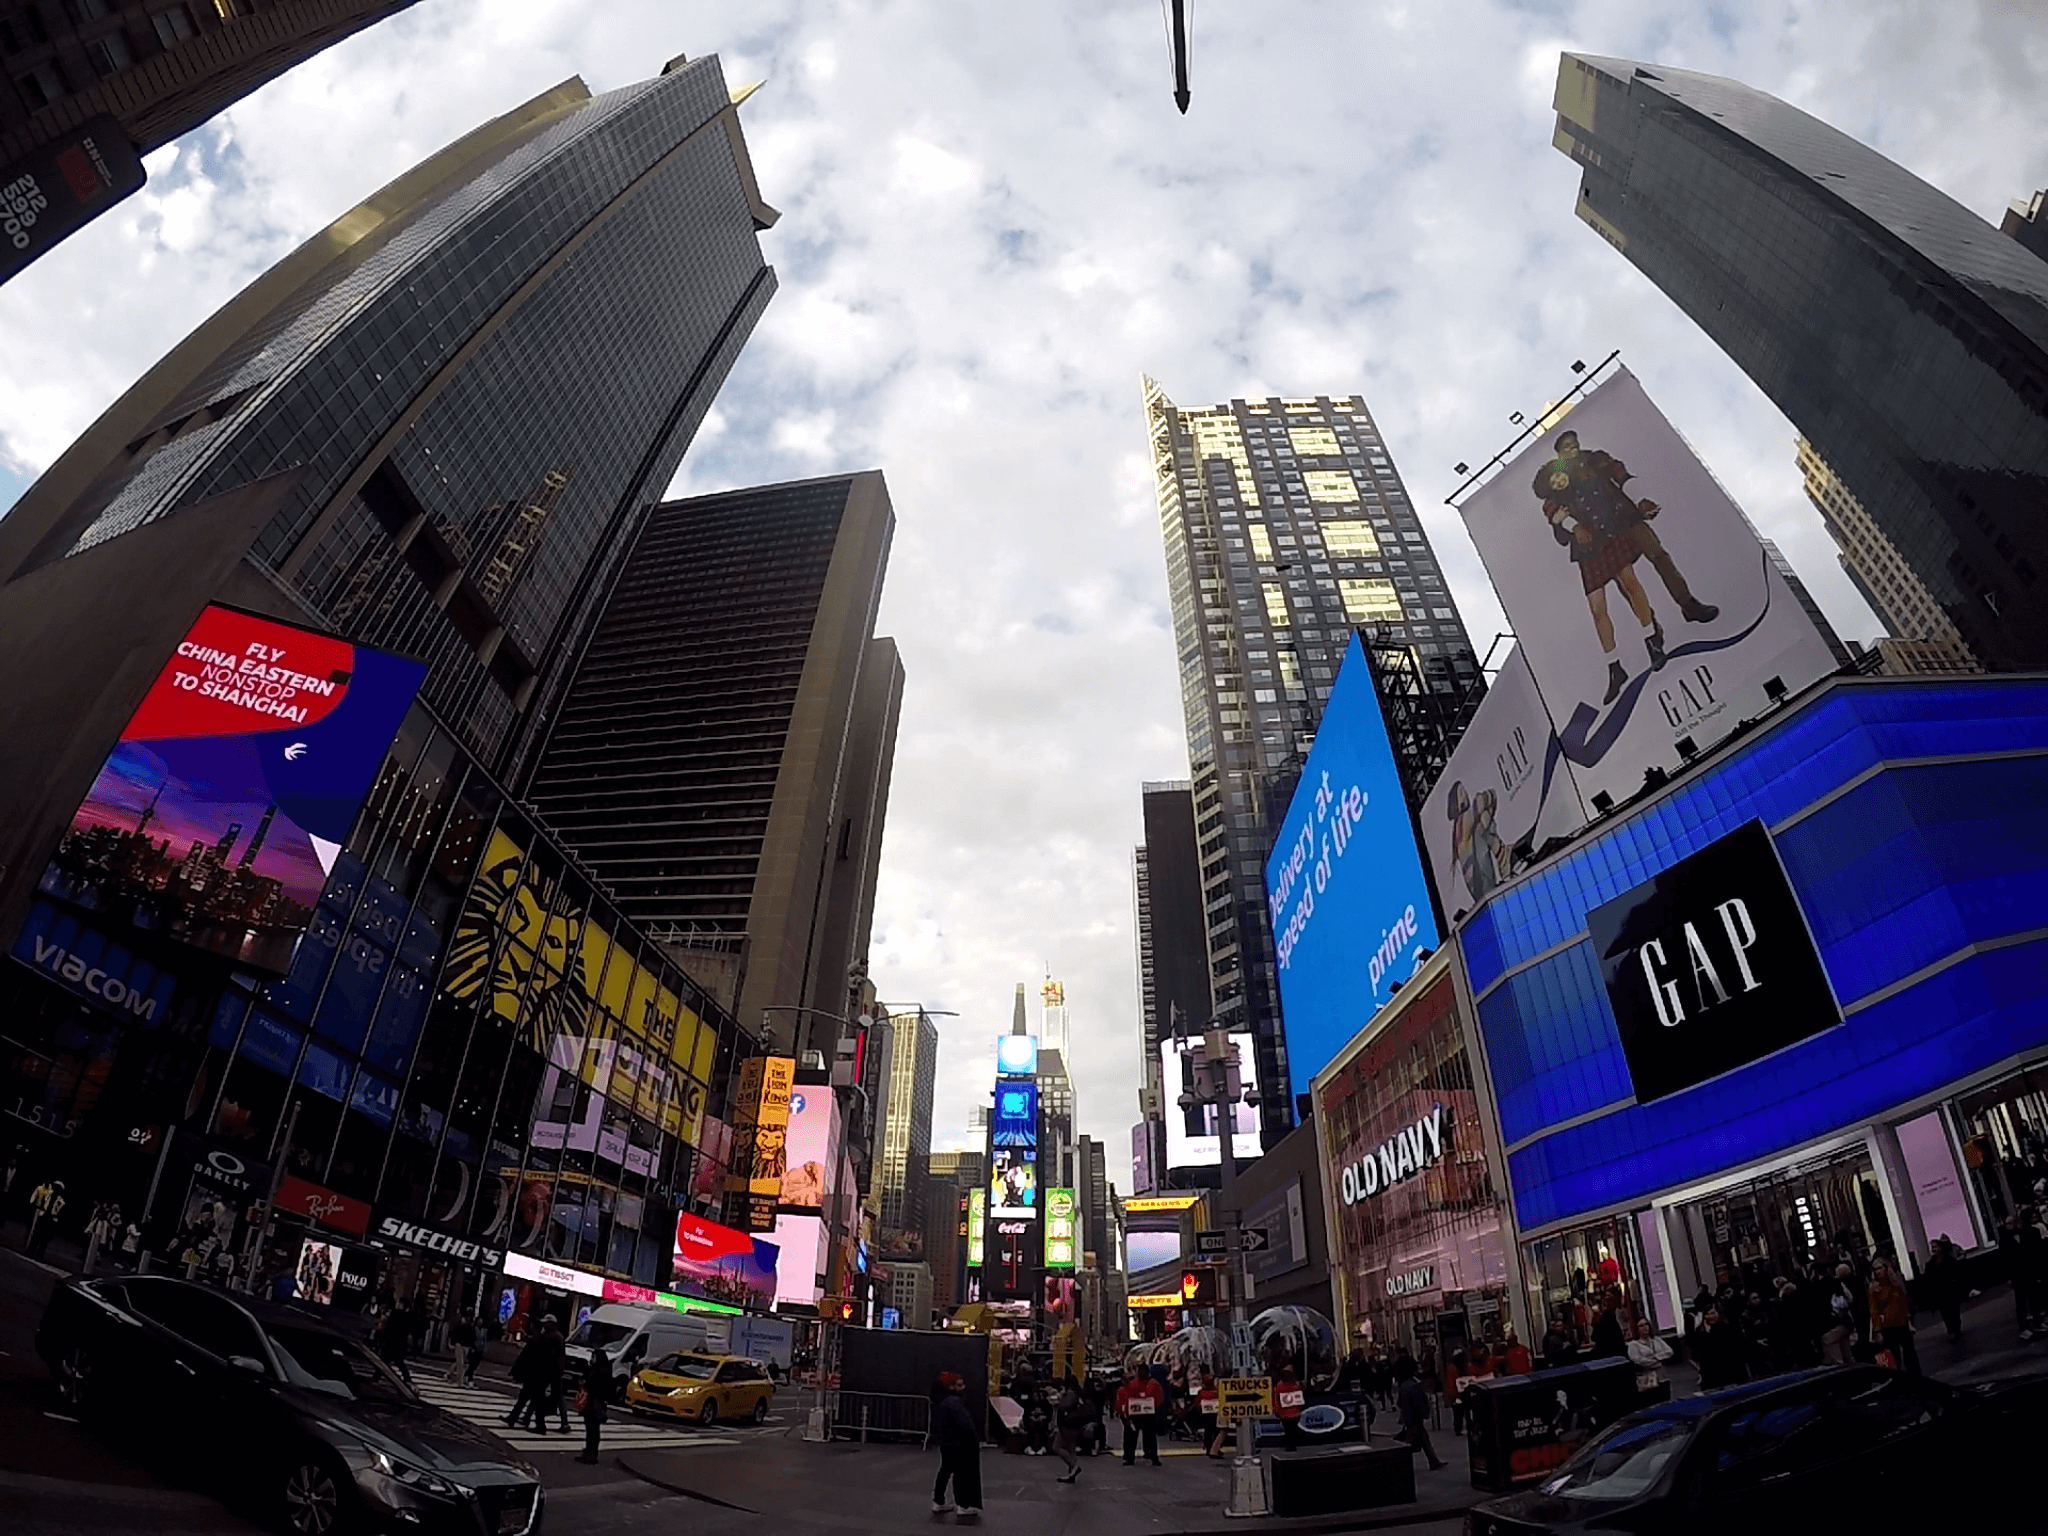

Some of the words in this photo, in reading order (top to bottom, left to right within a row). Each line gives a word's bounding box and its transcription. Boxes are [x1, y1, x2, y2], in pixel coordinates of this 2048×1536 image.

[3, 182, 37, 228] 599
[16, 173, 49, 213] 212
[177, 641, 236, 670] CHINA
[239, 659, 335, 696] EASTERN
[246, 642, 286, 662] FLY
[173, 671, 199, 690] TO
[198, 681, 308, 723] SHANGHAI
[200, 664, 296, 700] NONSTOP
[1658, 664, 1715, 728] GAP
[1496, 726, 1529, 792] GAP
[1315, 769, 1334, 823] at
[1277, 871, 1314, 969] speed
[1314, 831, 1331, 894] of
[1330, 785, 1369, 857] life.
[1368, 903, 1418, 997] prime
[1640, 898, 1762, 1026] GAP
[642, 998, 675, 1043] THE
[193, 1162, 251, 1190] OAKLEY
[1342, 1152, 1378, 1205] OLD
[1379, 1107, 1441, 1187] NAVY
[1206, 1238, 1224, 1248] ON
[1241, 1235, 1258, 1246] AY
[341, 1271, 369, 1288] POLO
[1386, 1275, 1404, 1296] OLD
[1404, 1265, 1430, 1293] NAVY
[1221, 1379, 1269, 1391] TRUCKS
[1222, 1405, 1270, 1417] TRUCKS
